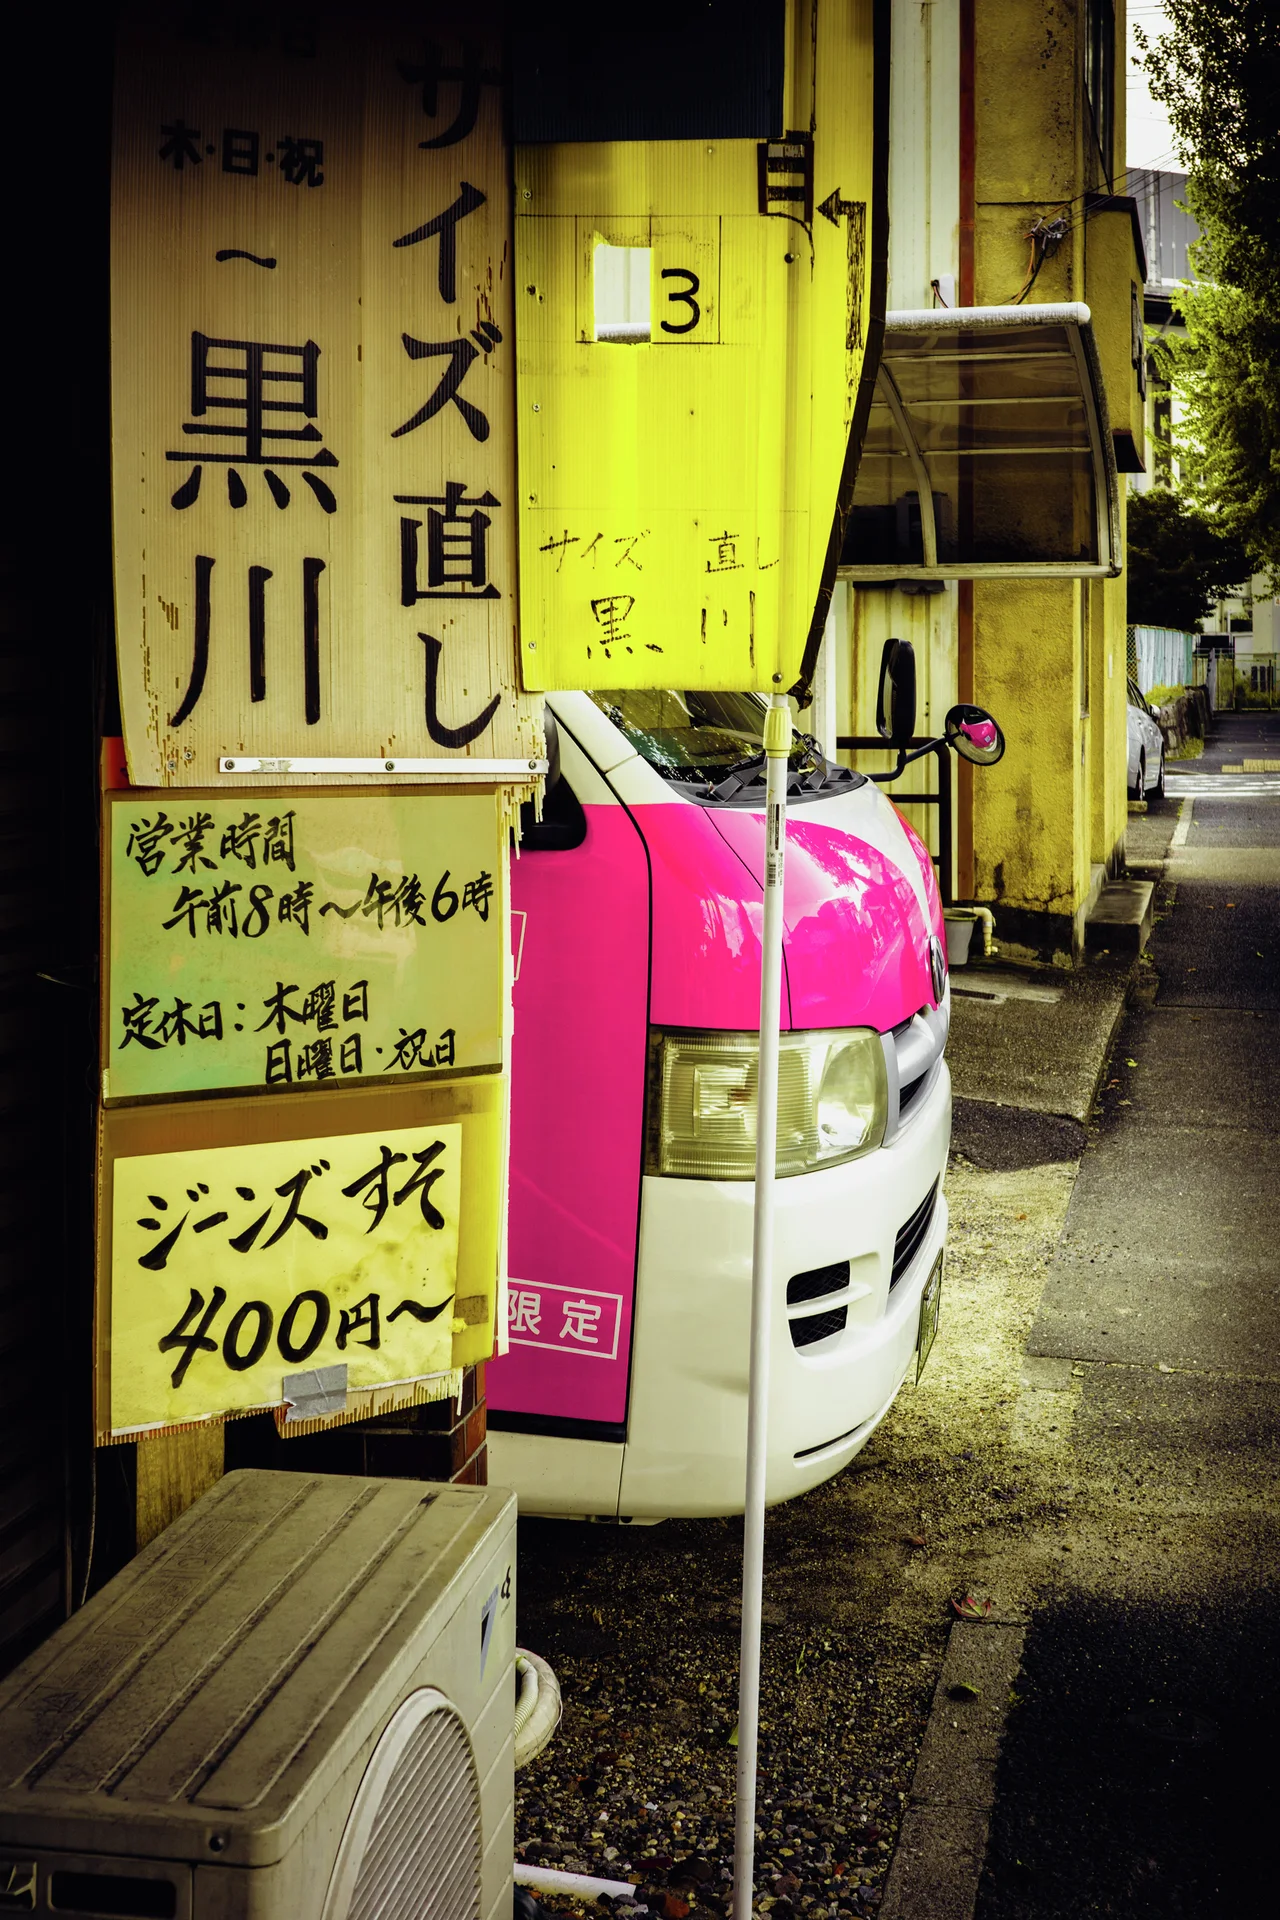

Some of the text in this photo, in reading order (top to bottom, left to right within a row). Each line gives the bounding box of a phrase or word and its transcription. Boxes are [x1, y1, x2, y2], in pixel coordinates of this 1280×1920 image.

[660, 267, 701, 335] 3
[391, 38, 513, 749] サイズ直し
[165, 330, 340, 728] 黒川
[125, 809, 297, 877] 営業時間
[508, 1288, 602, 1344] 限定
